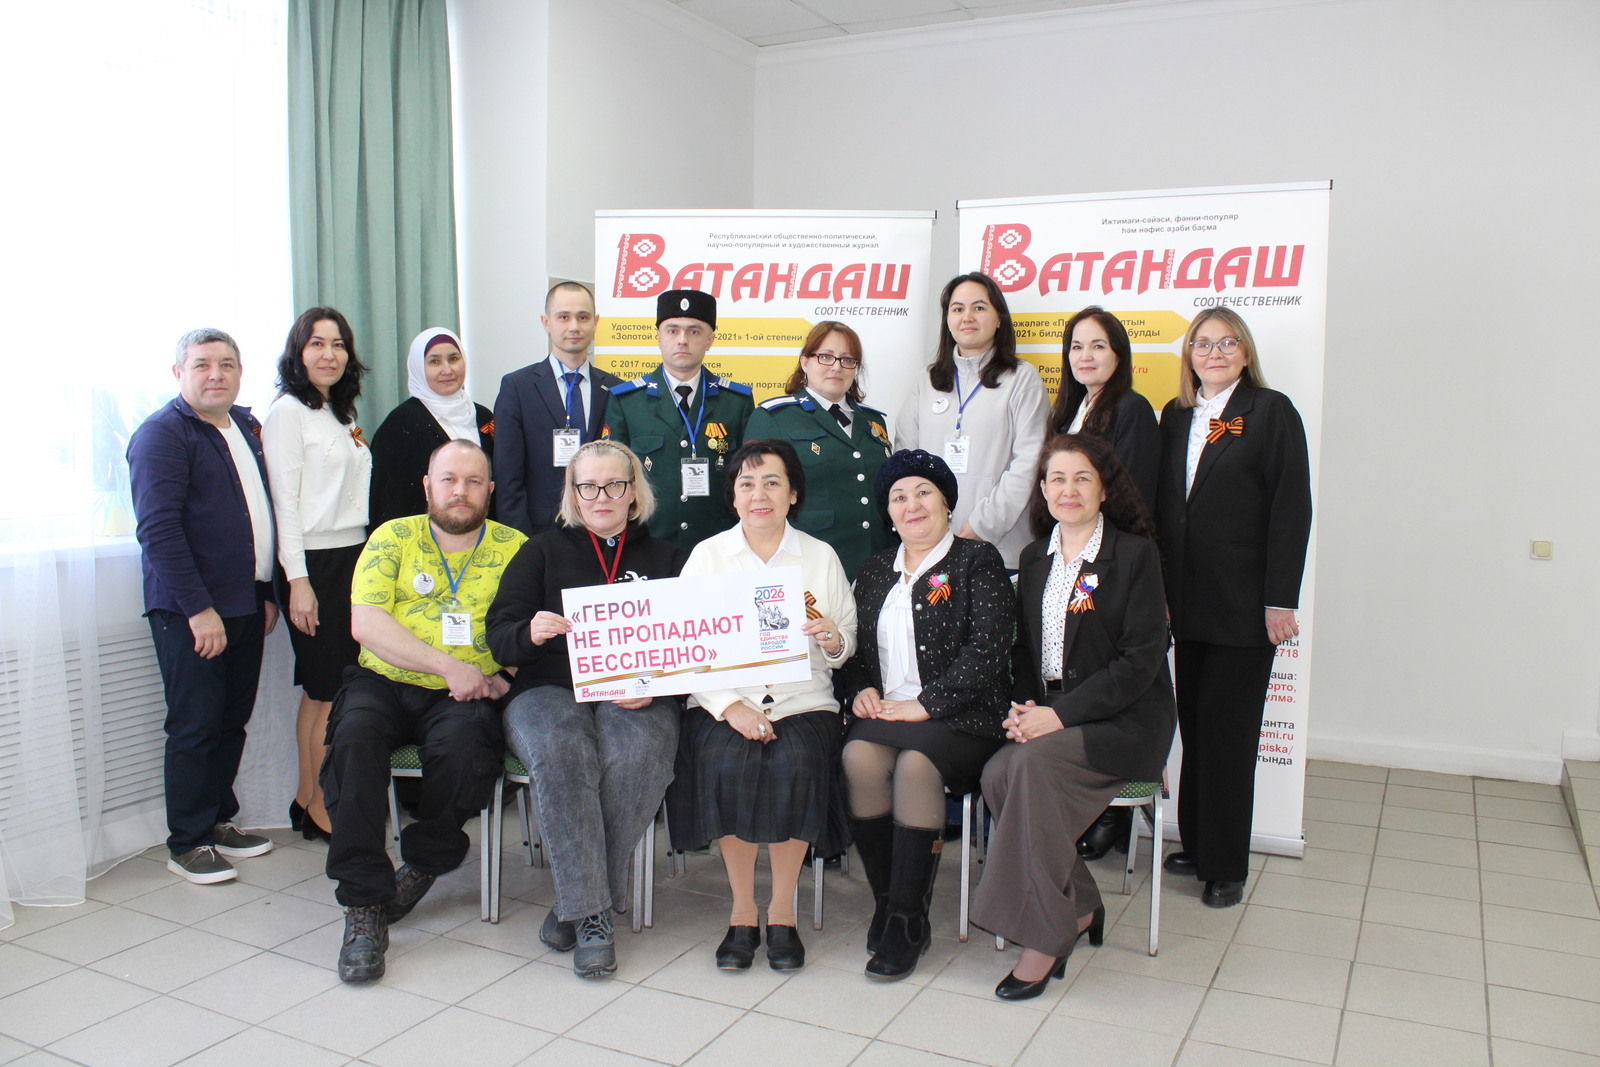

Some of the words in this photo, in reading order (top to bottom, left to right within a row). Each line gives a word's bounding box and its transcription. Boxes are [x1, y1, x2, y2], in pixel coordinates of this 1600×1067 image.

[709, 232, 772, 241] Республиканский
[774, 232, 878, 241] общественно-политический,
[707, 241, 780, 249] научно-популярный
[788, 241, 850, 250] художественный
[851, 242, 879, 250] журнал
[1194, 295, 1302, 308] СООТЕЧЕСТВЕННИК
[814, 305, 910, 317] СООТЕЧЕСТВЕННИК
[611, 323, 652, 331] Удостоен
[611, 332, 652, 340] «Золотой
[714, 333, 742, 341] -2021»
[745, 333, 764, 341] 1-ой
[1014, 329, 1037, 338] 021»
[1039, 329, 1064, 338] билд
[1128, 328, 1160, 338] булды
[611, 360, 617, 368] С
[619, 360, 639, 368] 2017
[1038, 365, 1063, 374] Рәсә
[756, 382, 788, 390] портал
[755, 588, 785, 600] 2026
[571, 598, 651, 624] «ГЕРОИ
[573, 629, 601, 649] НЕ
[608, 614, 744, 646] ПРОПАДАЮТ
[760, 634, 788, 642] ЕДИНСТВА
[1274, 648, 1299, 658] 2718
[577, 645, 718, 674] БЕССЛЕДНО»
[1267, 682, 1297, 693] орто,
[1265, 694, 1296, 703] үлмә.
[1263, 719, 1295, 729] антта
[1259, 730, 1294, 741] smi.ru
[1259, 742, 1294, 756] piska/
[1257, 754, 1293, 766] тында
